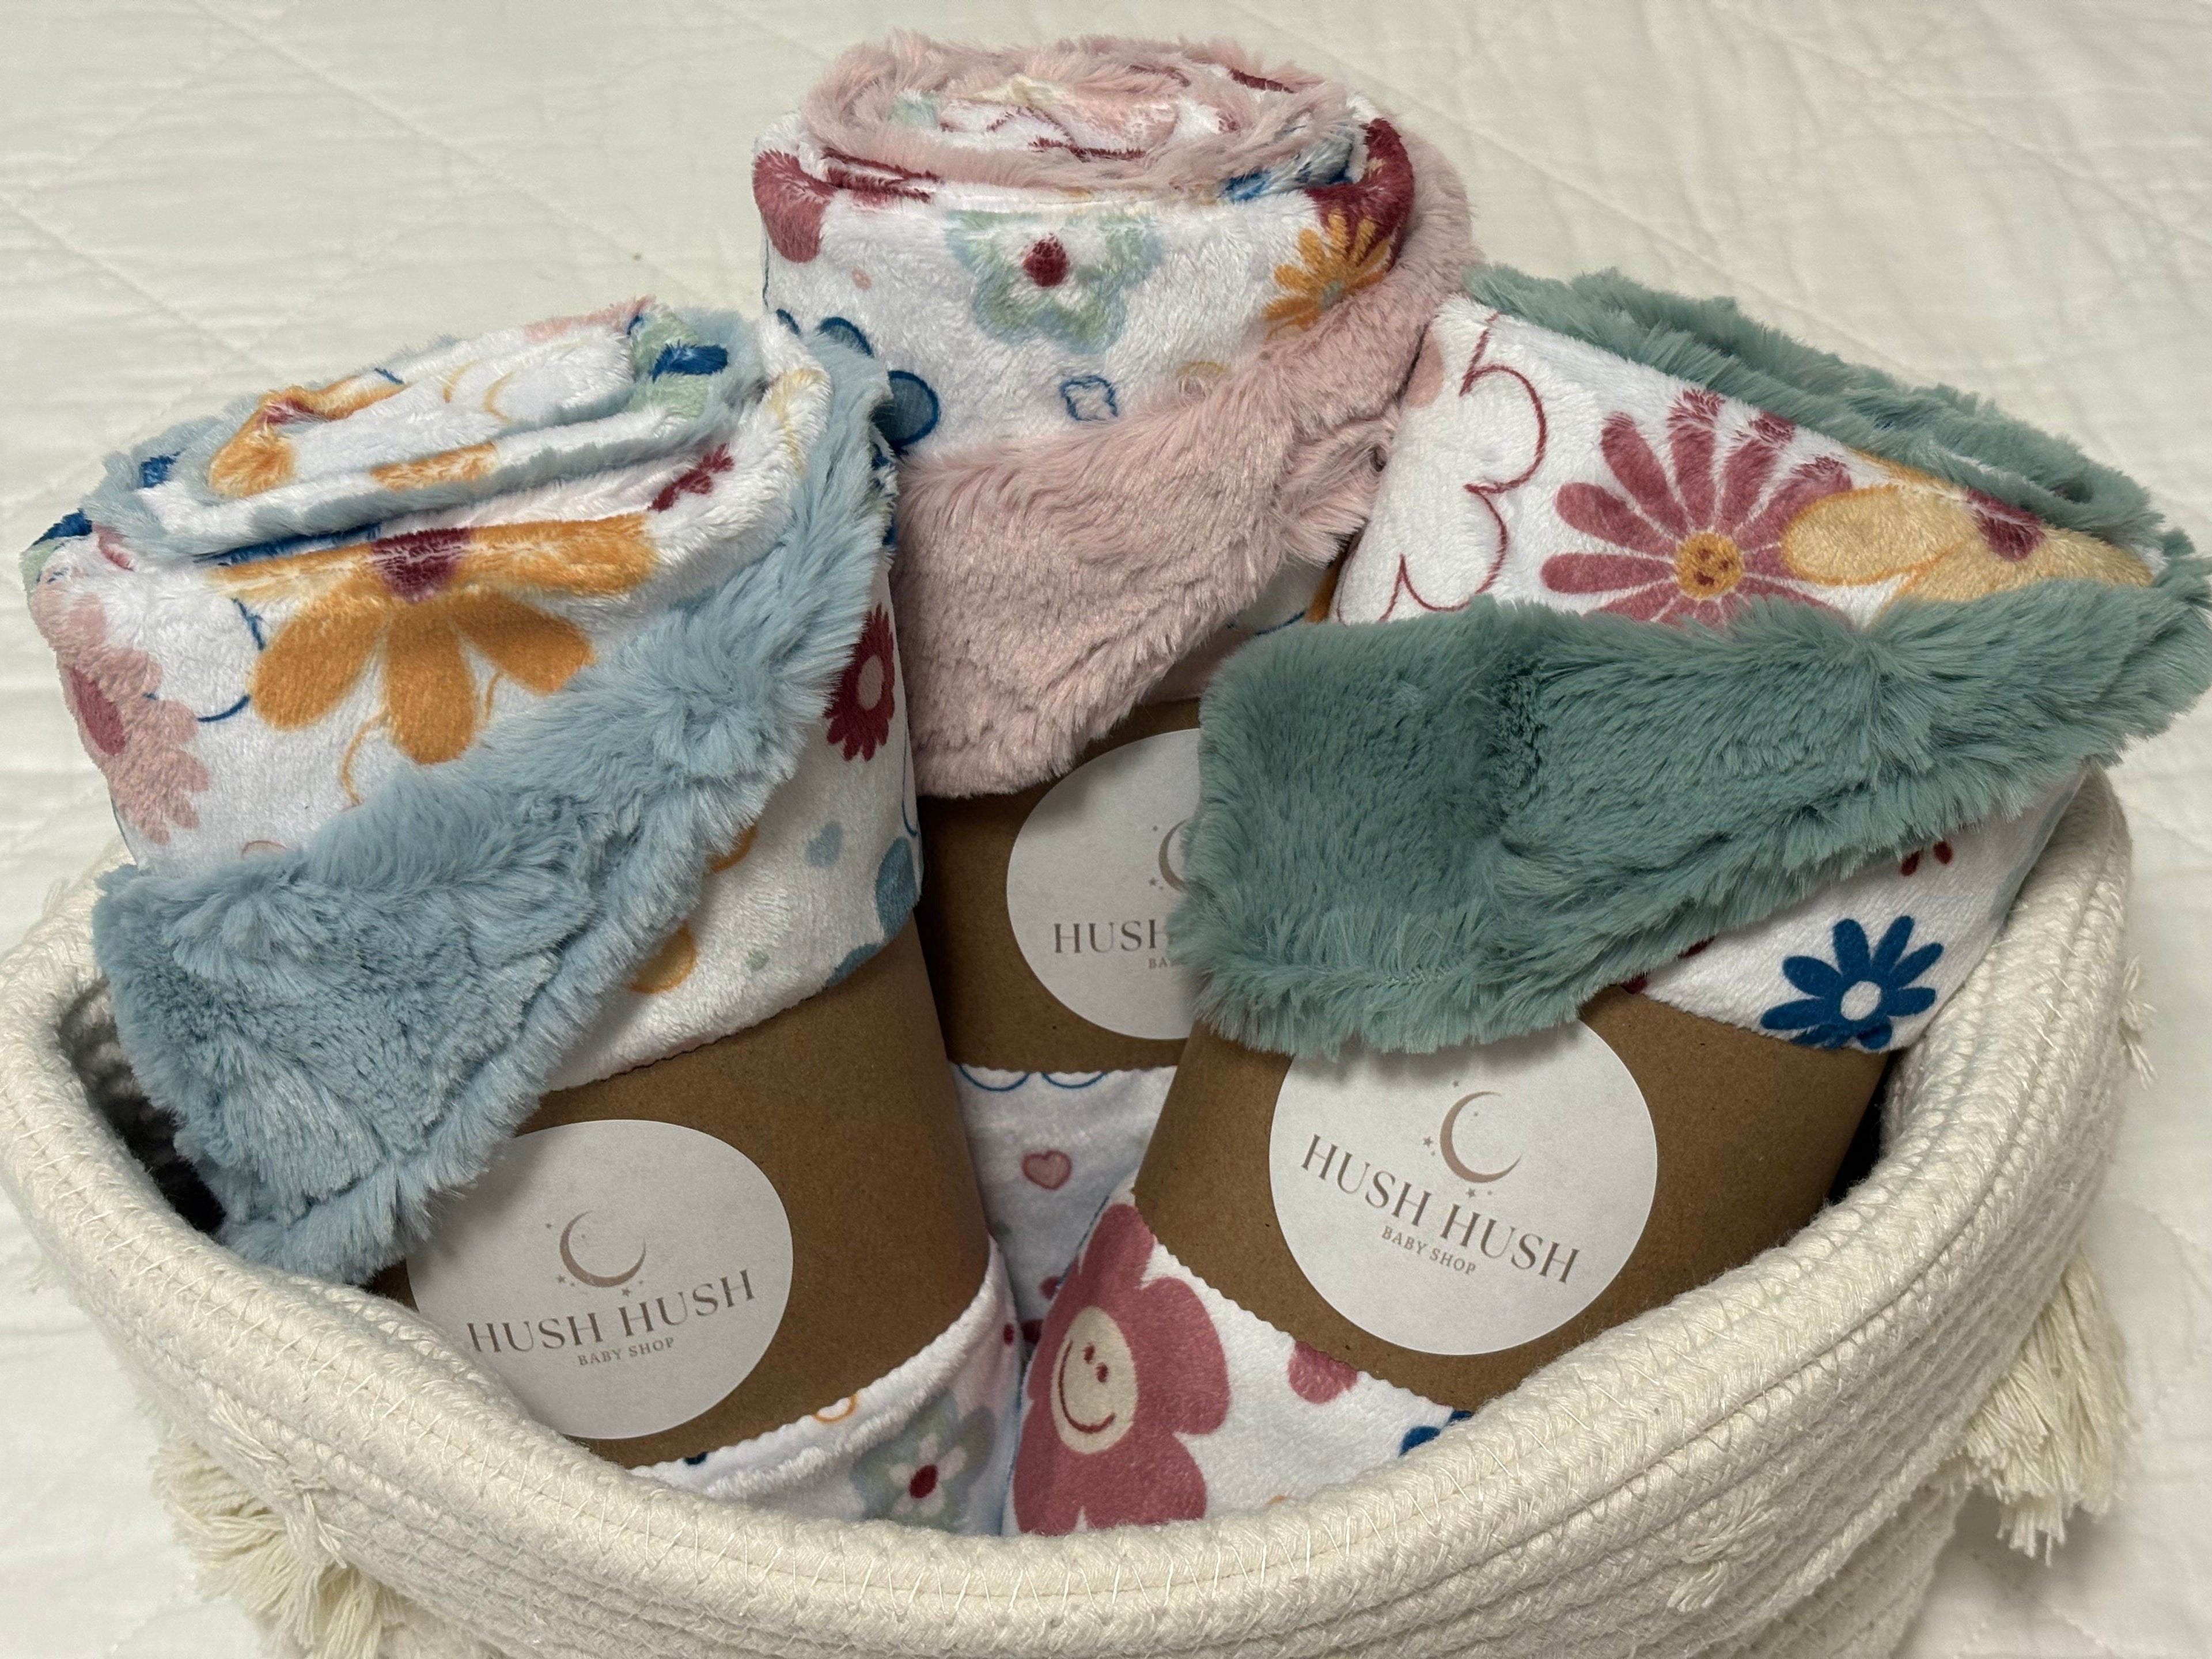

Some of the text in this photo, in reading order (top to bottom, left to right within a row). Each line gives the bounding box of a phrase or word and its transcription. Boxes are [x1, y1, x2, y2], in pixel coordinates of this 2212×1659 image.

[1149, 957, 1173, 969] BA
[1300, 1134, 1580, 1284] HUSH HUSH
[1381, 1225, 1476, 1275] BABY SHOP
[467, 1268, 755, 1353] HUSH HUSH
[577, 1336, 675, 1366] BABY SHOP
